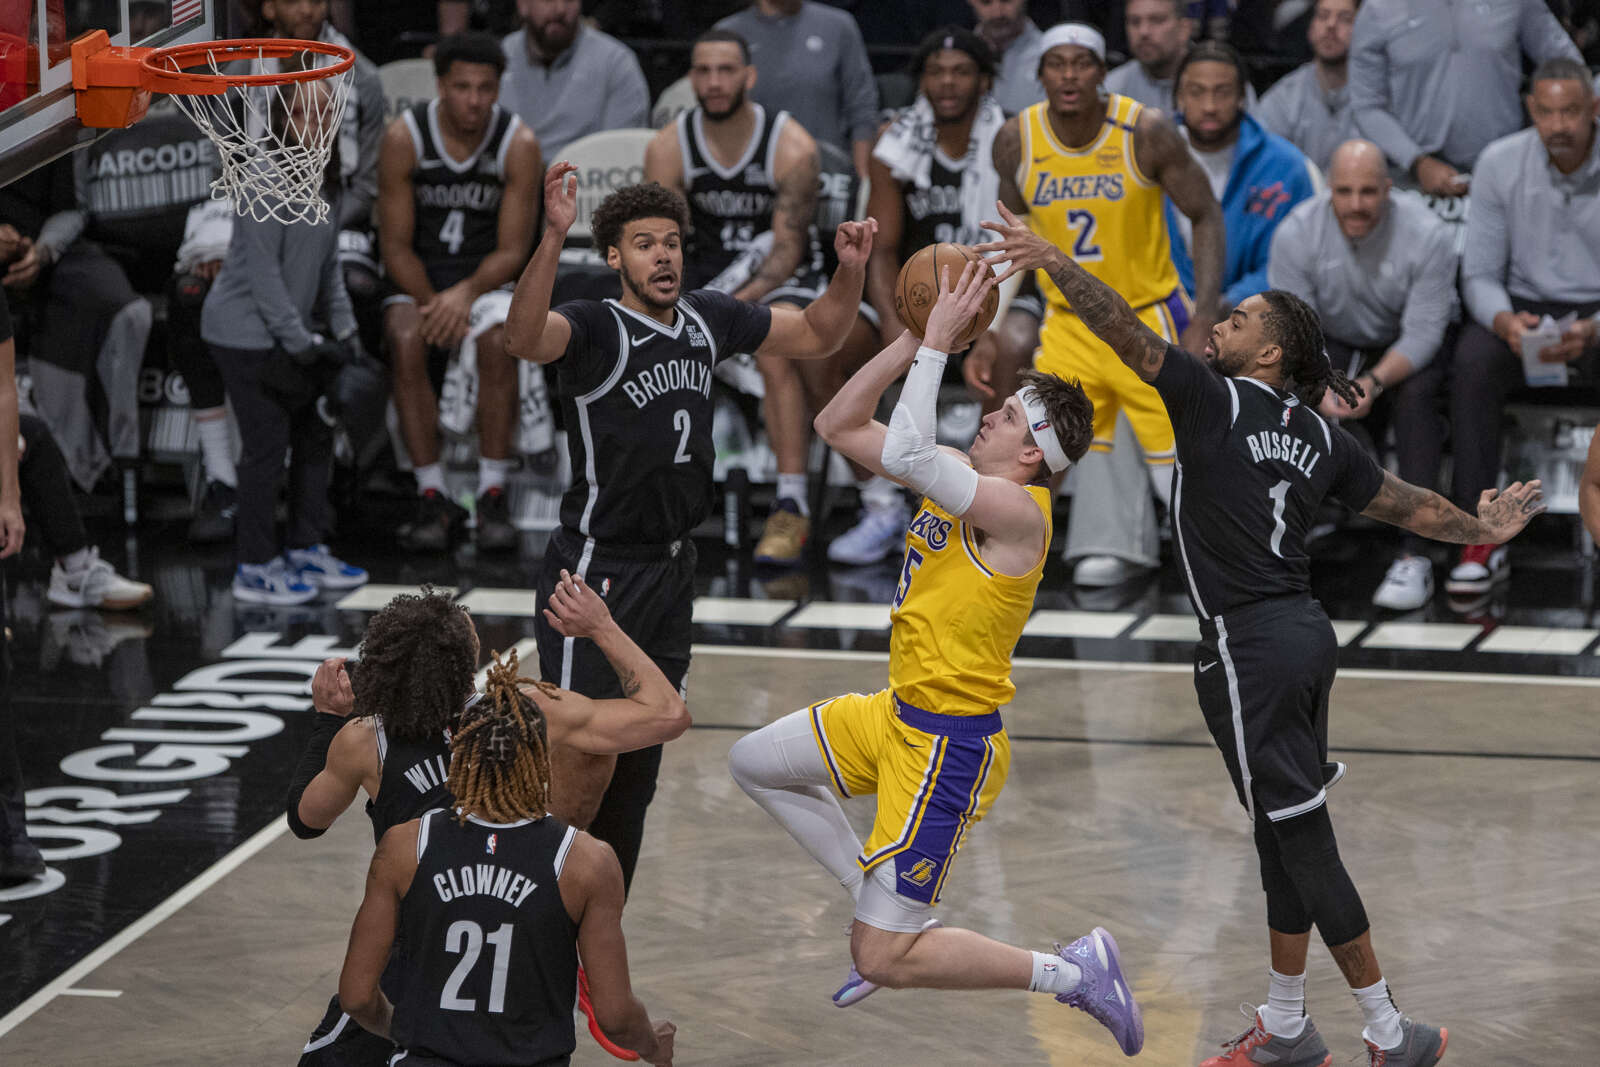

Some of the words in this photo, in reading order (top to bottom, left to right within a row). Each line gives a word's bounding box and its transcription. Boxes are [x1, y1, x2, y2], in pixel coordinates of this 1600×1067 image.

[92, 138, 213, 176] ARCODE
[416, 182, 500, 210] ROOKLY
[1032, 171, 1125, 207] LAKERS
[439, 210, 465, 254] 4
[1067, 210, 1104, 262] 2
[622, 358, 712, 409] BROOKLYN
[673, 409, 692, 464] 2
[1246, 430, 1321, 480] RUSSELL
[1269, 479, 1293, 559] 1
[403, 752, 455, 794] WIL
[433, 863, 539, 908] CLOWNEY
[439, 920, 515, 1013] 21
